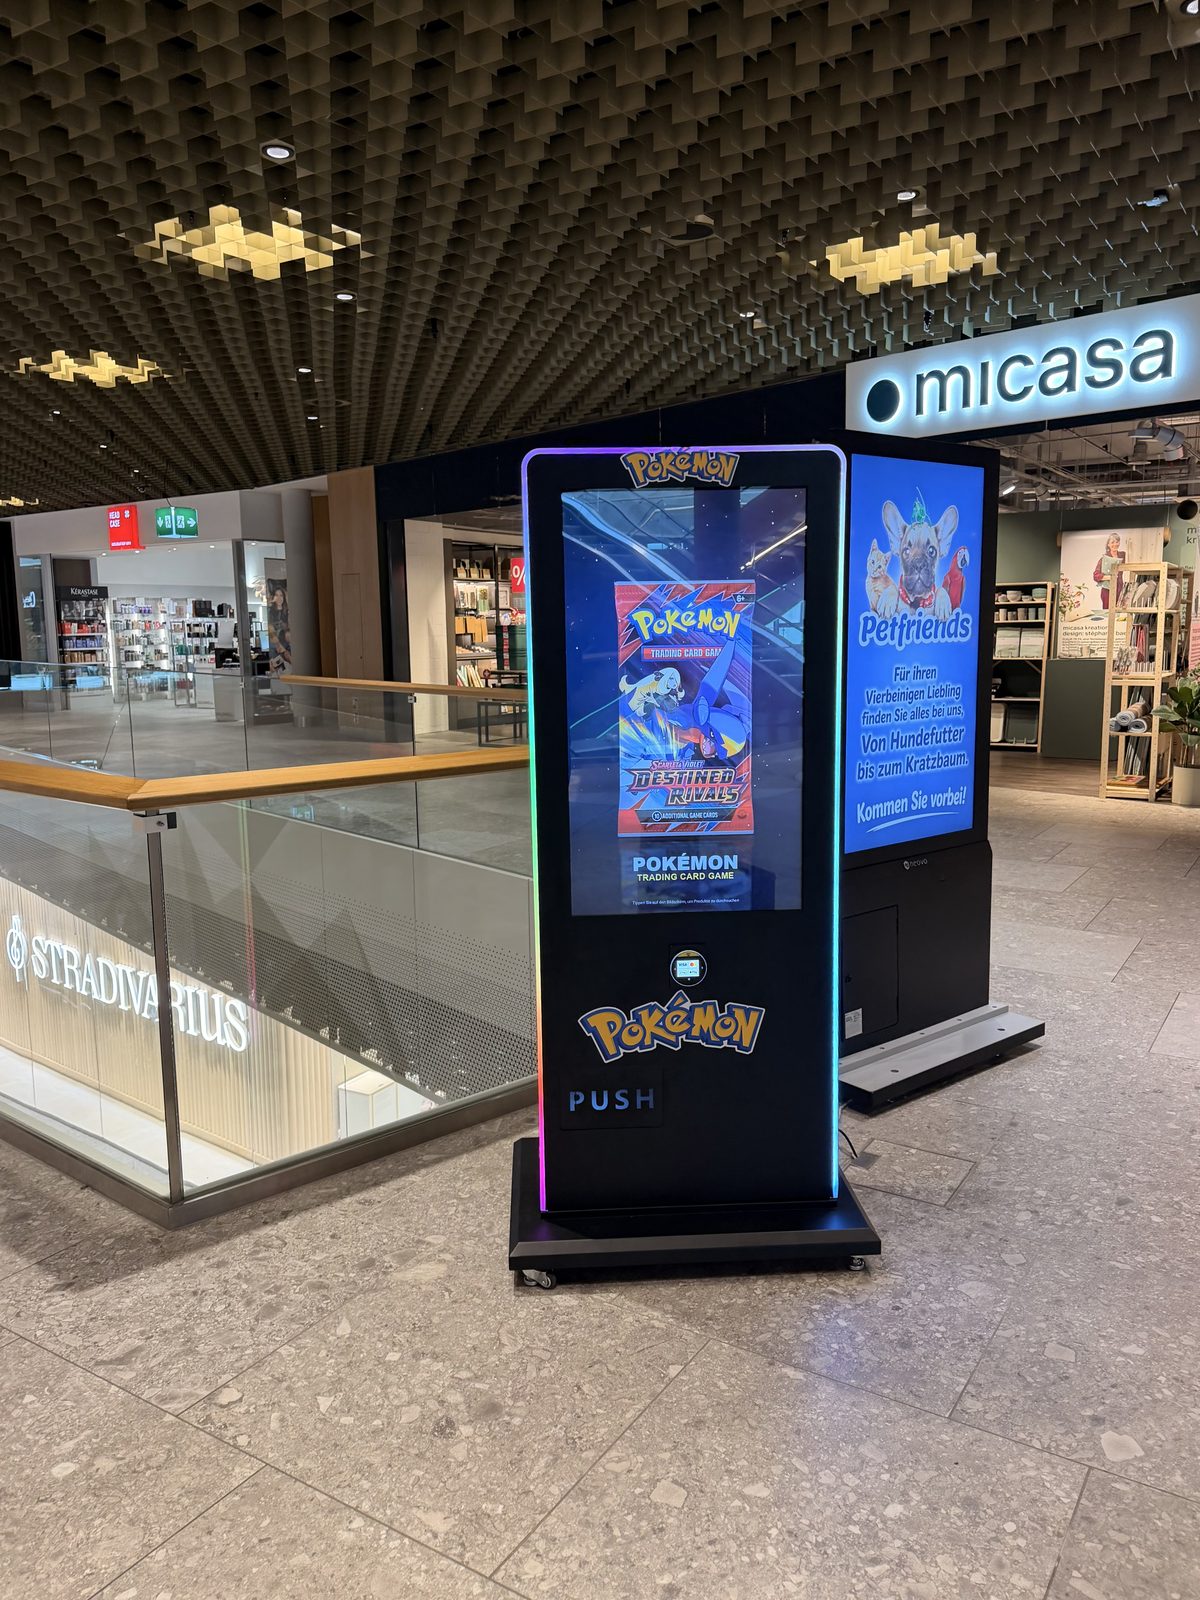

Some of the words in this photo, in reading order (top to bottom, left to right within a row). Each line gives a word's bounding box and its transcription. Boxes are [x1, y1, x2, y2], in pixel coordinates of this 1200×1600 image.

[915, 329, 1175, 416] micasa
[109, 511, 120, 519] HEAD
[109, 519, 120, 528] CASE
[736, 594, 745, 603] 6+
[860, 609, 971, 648] Petfriends
[650, 649, 682, 658] TRADING
[684, 648, 703, 657] CARD
[893, 666, 910, 682] Für
[912, 665, 937, 680] ihren
[865, 688, 925, 705] Vierbeinigen
[927, 685, 961, 700] Liebling
[861, 710, 892, 725] finden
[894, 708, 908, 722] Sie
[910, 706, 930, 720] alles
[932, 705, 945, 718] bei
[947, 705, 964, 717] uns,
[861, 734, 887, 754] Von
[890, 726, 965, 750] Hundefutter
[857, 762, 875, 781] bis
[877, 762, 902, 778] zum
[905, 751, 969, 773] Kratzbaum.
[633, 768, 737, 789] DESTINED
[668, 786, 739, 805] RIVALS
[856, 798, 908, 824] Kommen
[911, 790, 928, 811] Sie
[930, 786, 967, 807] vorbei!
[633, 853, 738, 872] POKÉMON
[637, 873, 678, 882] TRADING
[680, 872, 706, 881] CARD
[708, 871, 734, 880] GAME
[569, 1088, 654, 1112] PUSH
